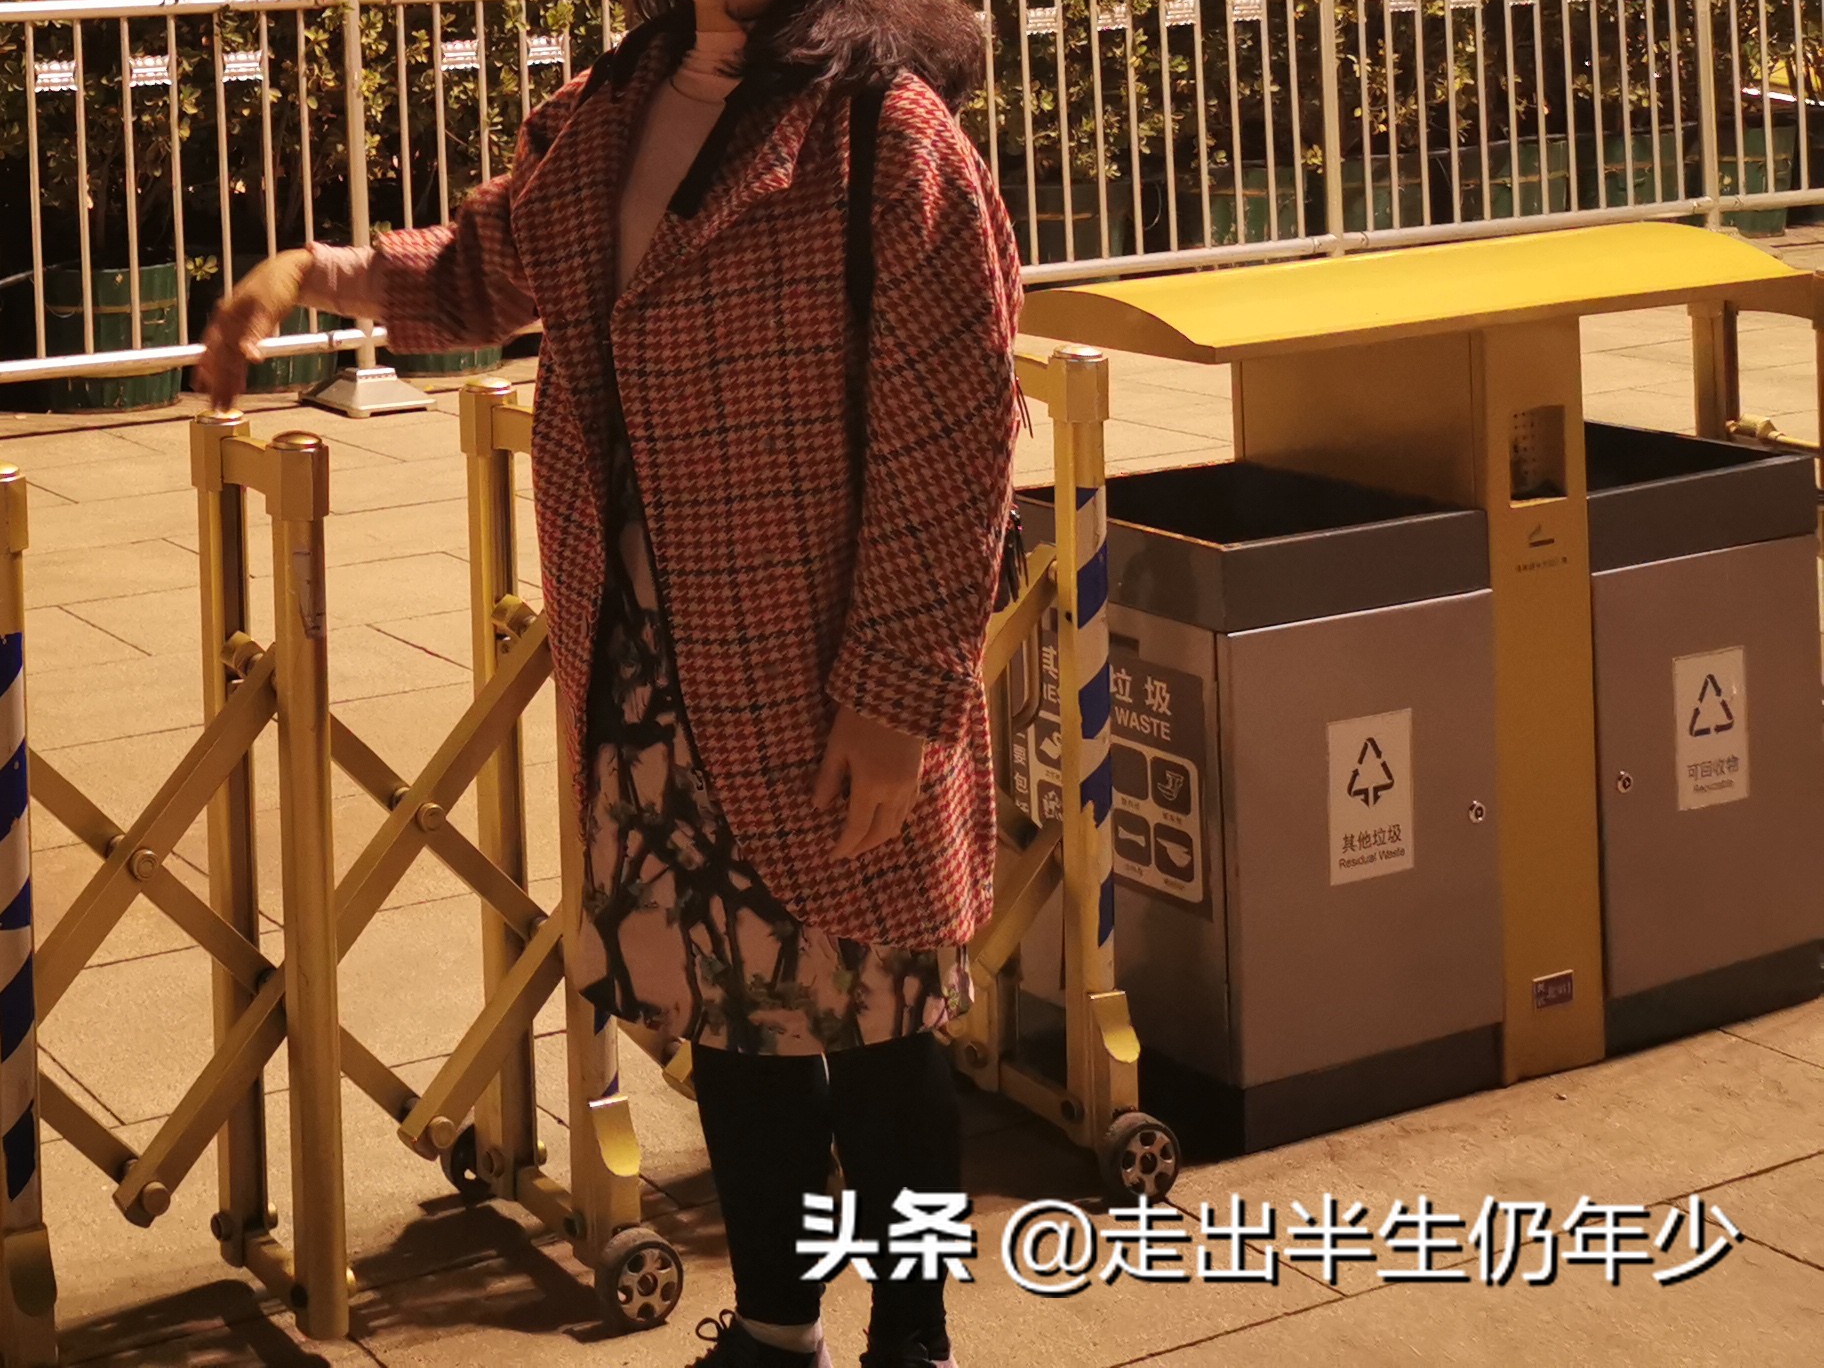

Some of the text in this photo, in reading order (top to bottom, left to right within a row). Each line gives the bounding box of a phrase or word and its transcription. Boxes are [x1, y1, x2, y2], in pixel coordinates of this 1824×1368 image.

[1114, 705, 1172, 742] WASTE
[1342, 823, 1402, 854] 其他垃圾
[1338, 852, 1377, 870] Residual
